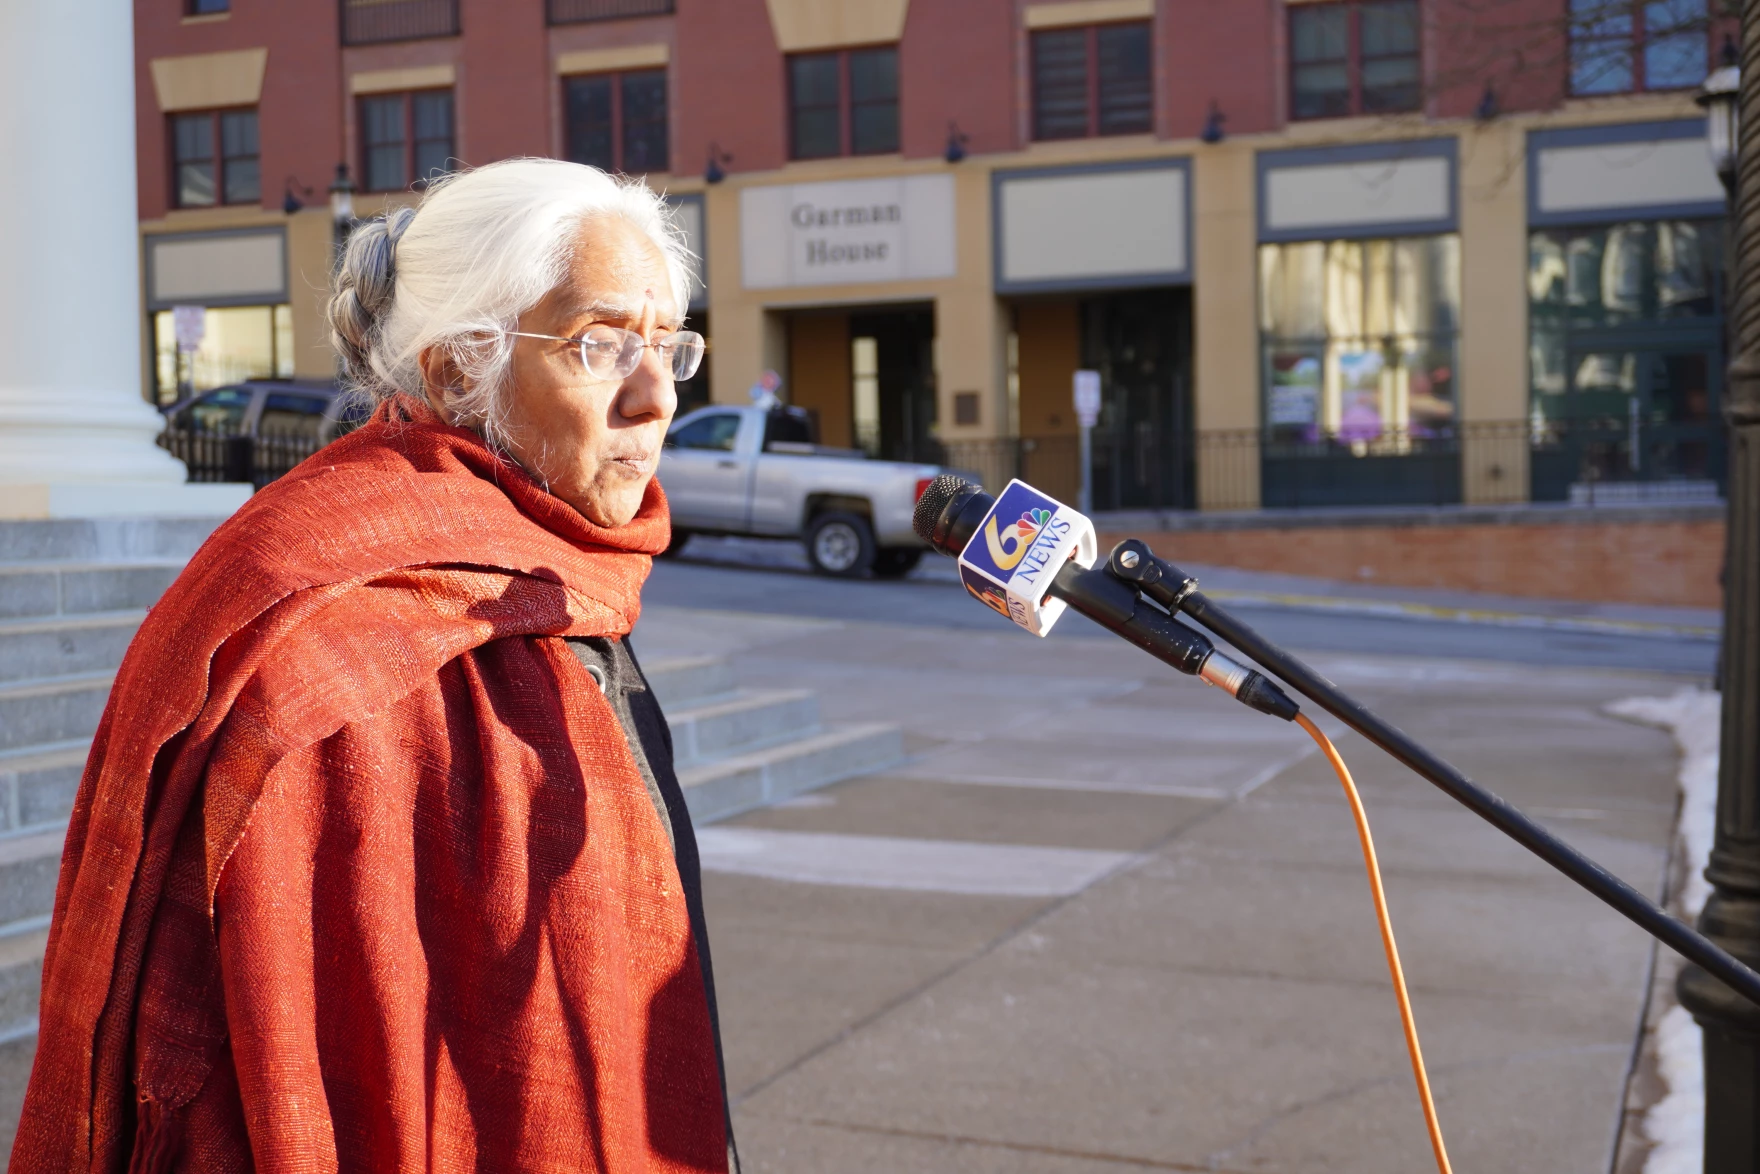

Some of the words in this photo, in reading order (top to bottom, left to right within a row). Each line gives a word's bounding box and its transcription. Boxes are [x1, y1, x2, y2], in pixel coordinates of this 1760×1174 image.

[791, 203, 902, 229] Garman
[806, 239, 889, 265] House
[985, 514, 1030, 570] 6
[1016, 517, 1071, 585] NEWS
